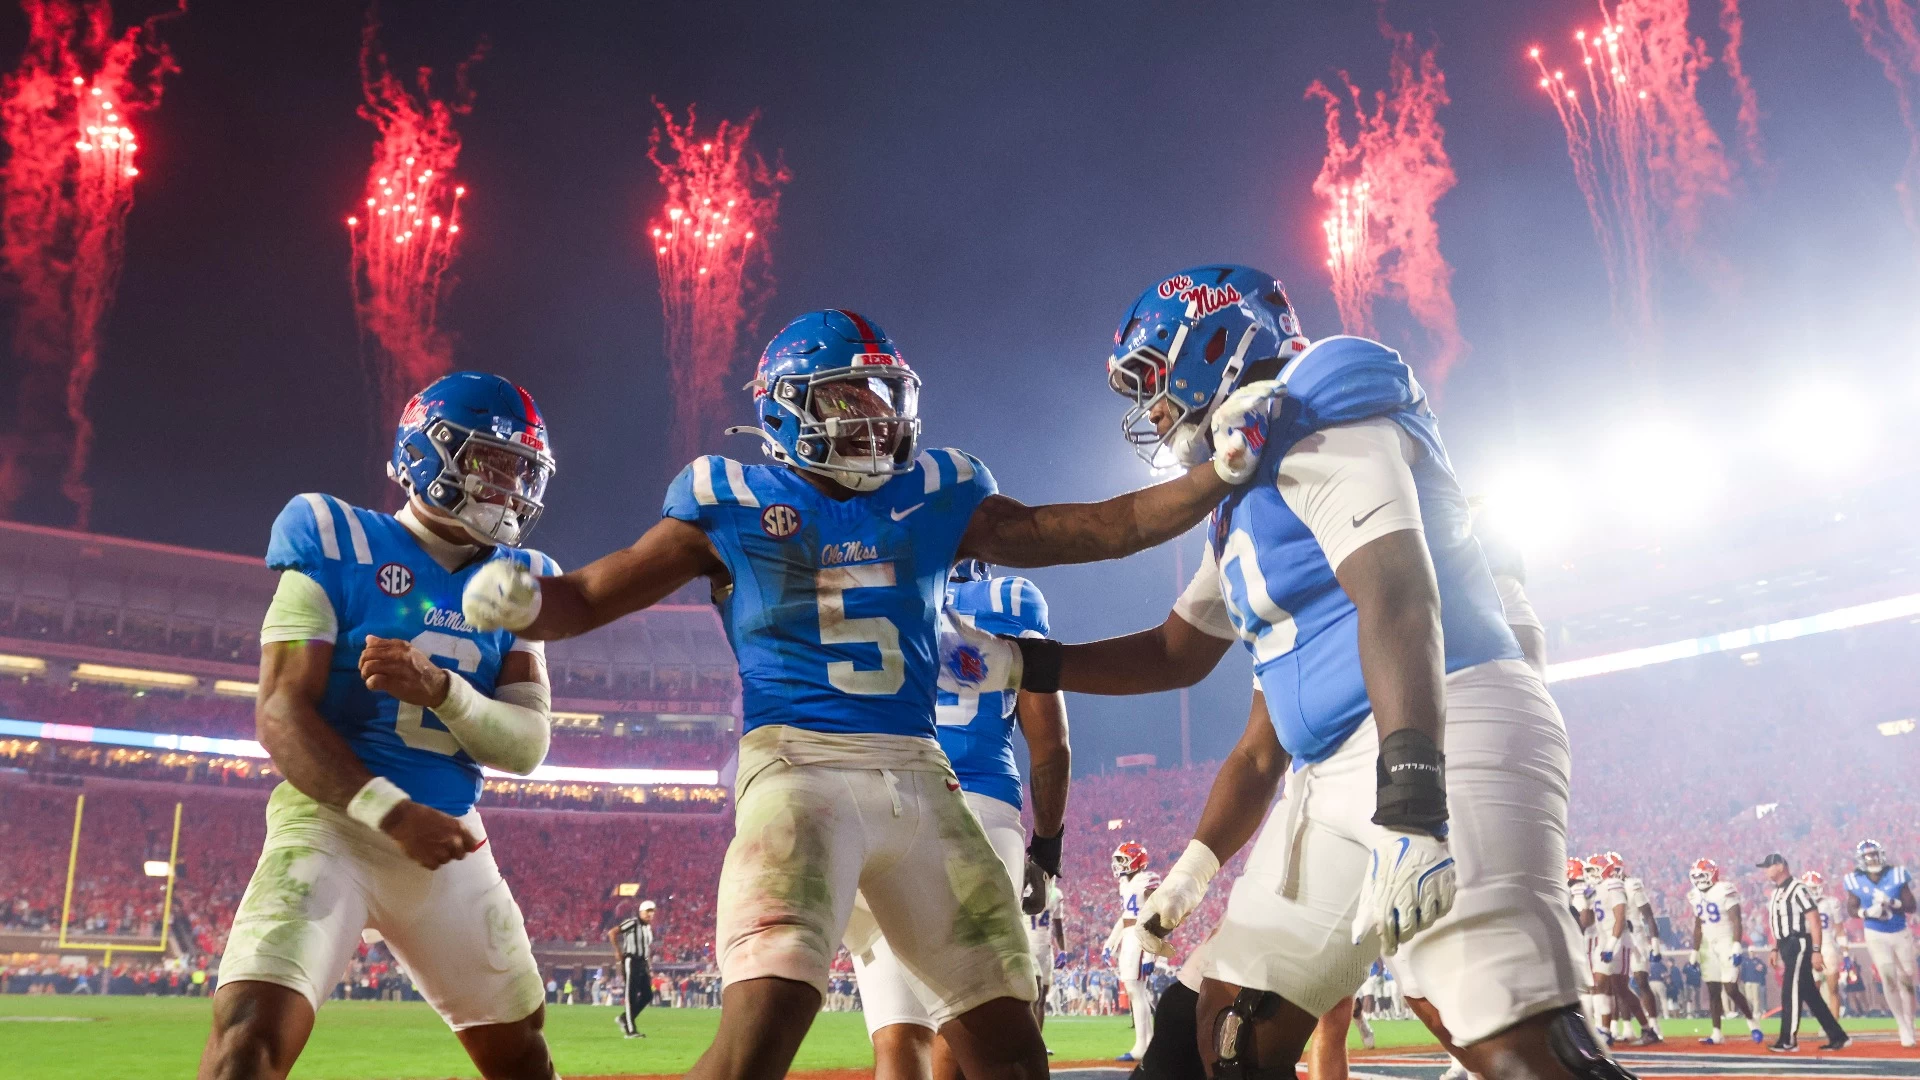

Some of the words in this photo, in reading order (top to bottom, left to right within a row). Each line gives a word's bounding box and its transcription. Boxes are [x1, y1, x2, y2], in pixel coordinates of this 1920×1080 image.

[1158, 275, 1193, 299] Ole
[1179, 283, 1241, 319] Miss
[861, 354, 893, 366] REBS
[764, 505, 798, 536] SEC
[821, 543, 844, 566] Ole
[842, 540, 879, 562] Miss
[379, 563, 411, 595] SEC
[423, 606, 445, 627] Ole
[815, 562, 906, 695] 5
